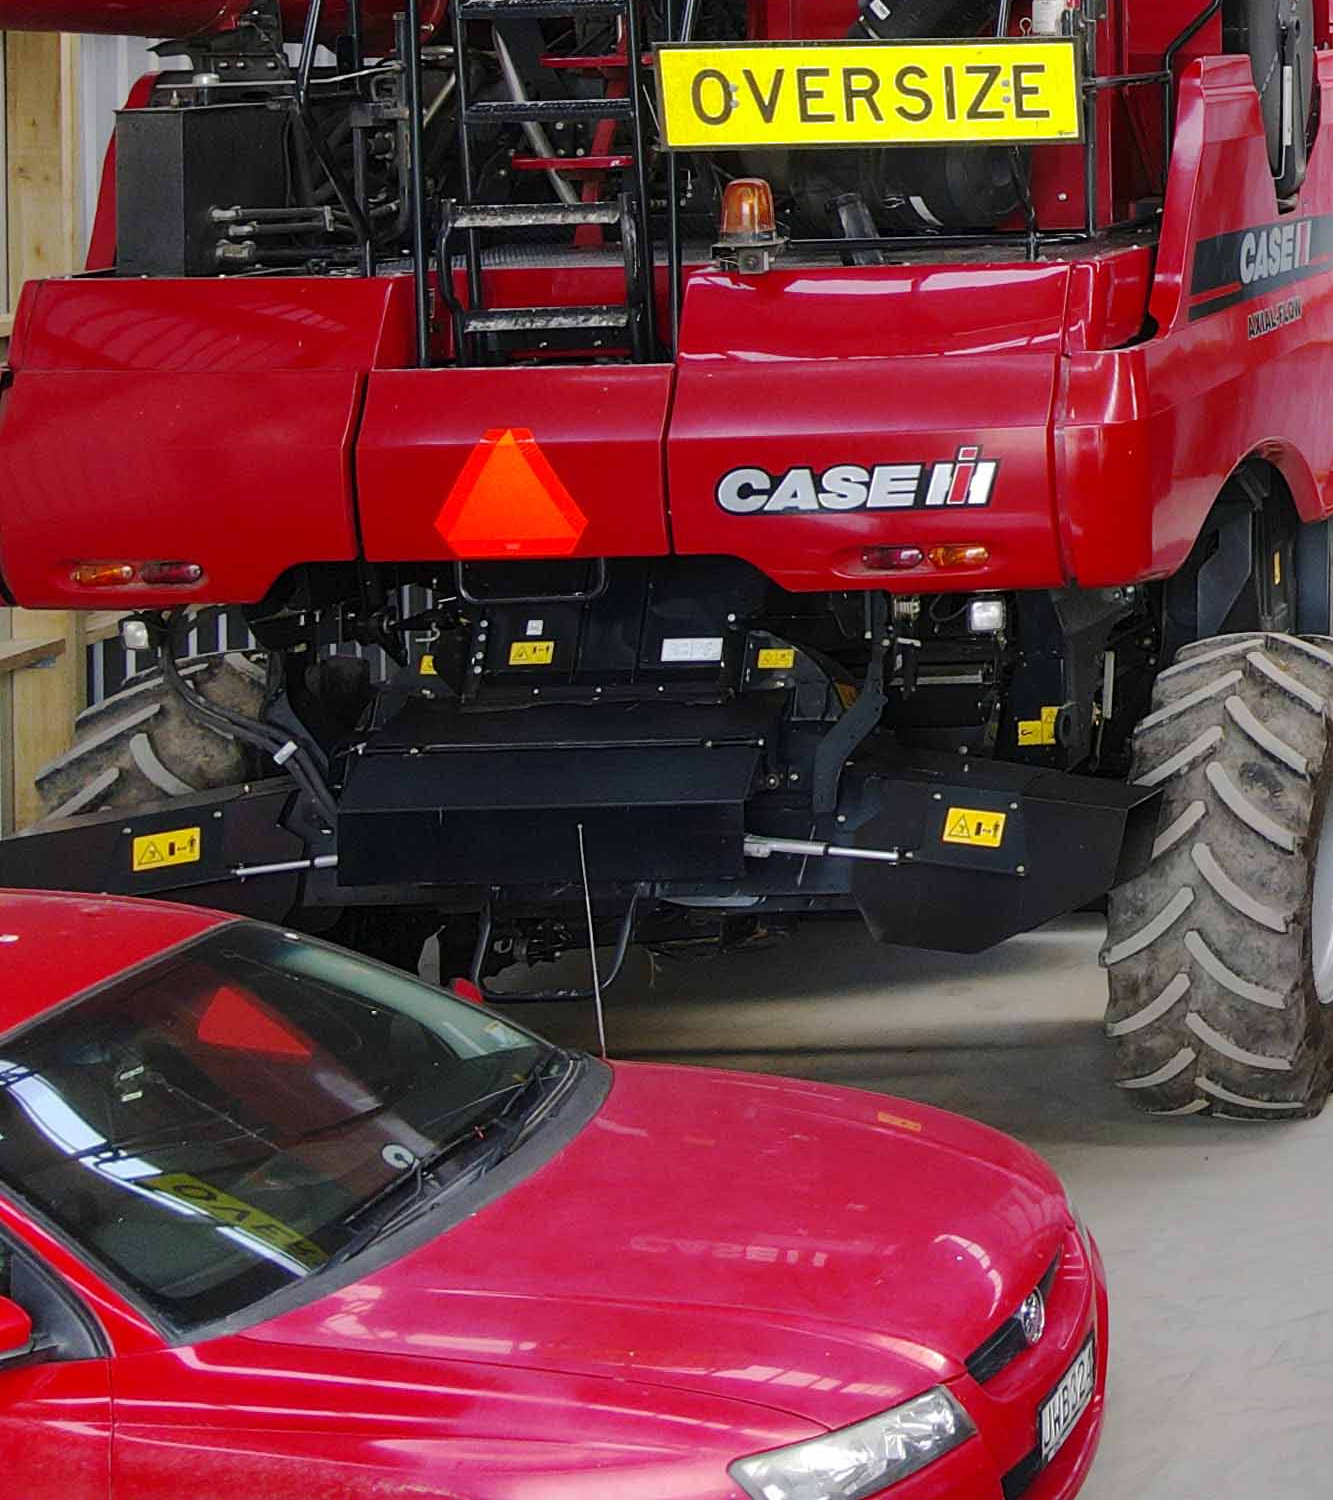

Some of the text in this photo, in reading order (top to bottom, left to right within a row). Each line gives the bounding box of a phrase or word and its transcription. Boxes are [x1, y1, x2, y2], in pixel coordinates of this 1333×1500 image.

[691, 64, 1051, 126] OVERSIZE
[1240, 224, 1296, 285] CASE
[1248, 297, 1303, 339] AXIAL-FLOW
[717, 464, 923, 514] CASE
